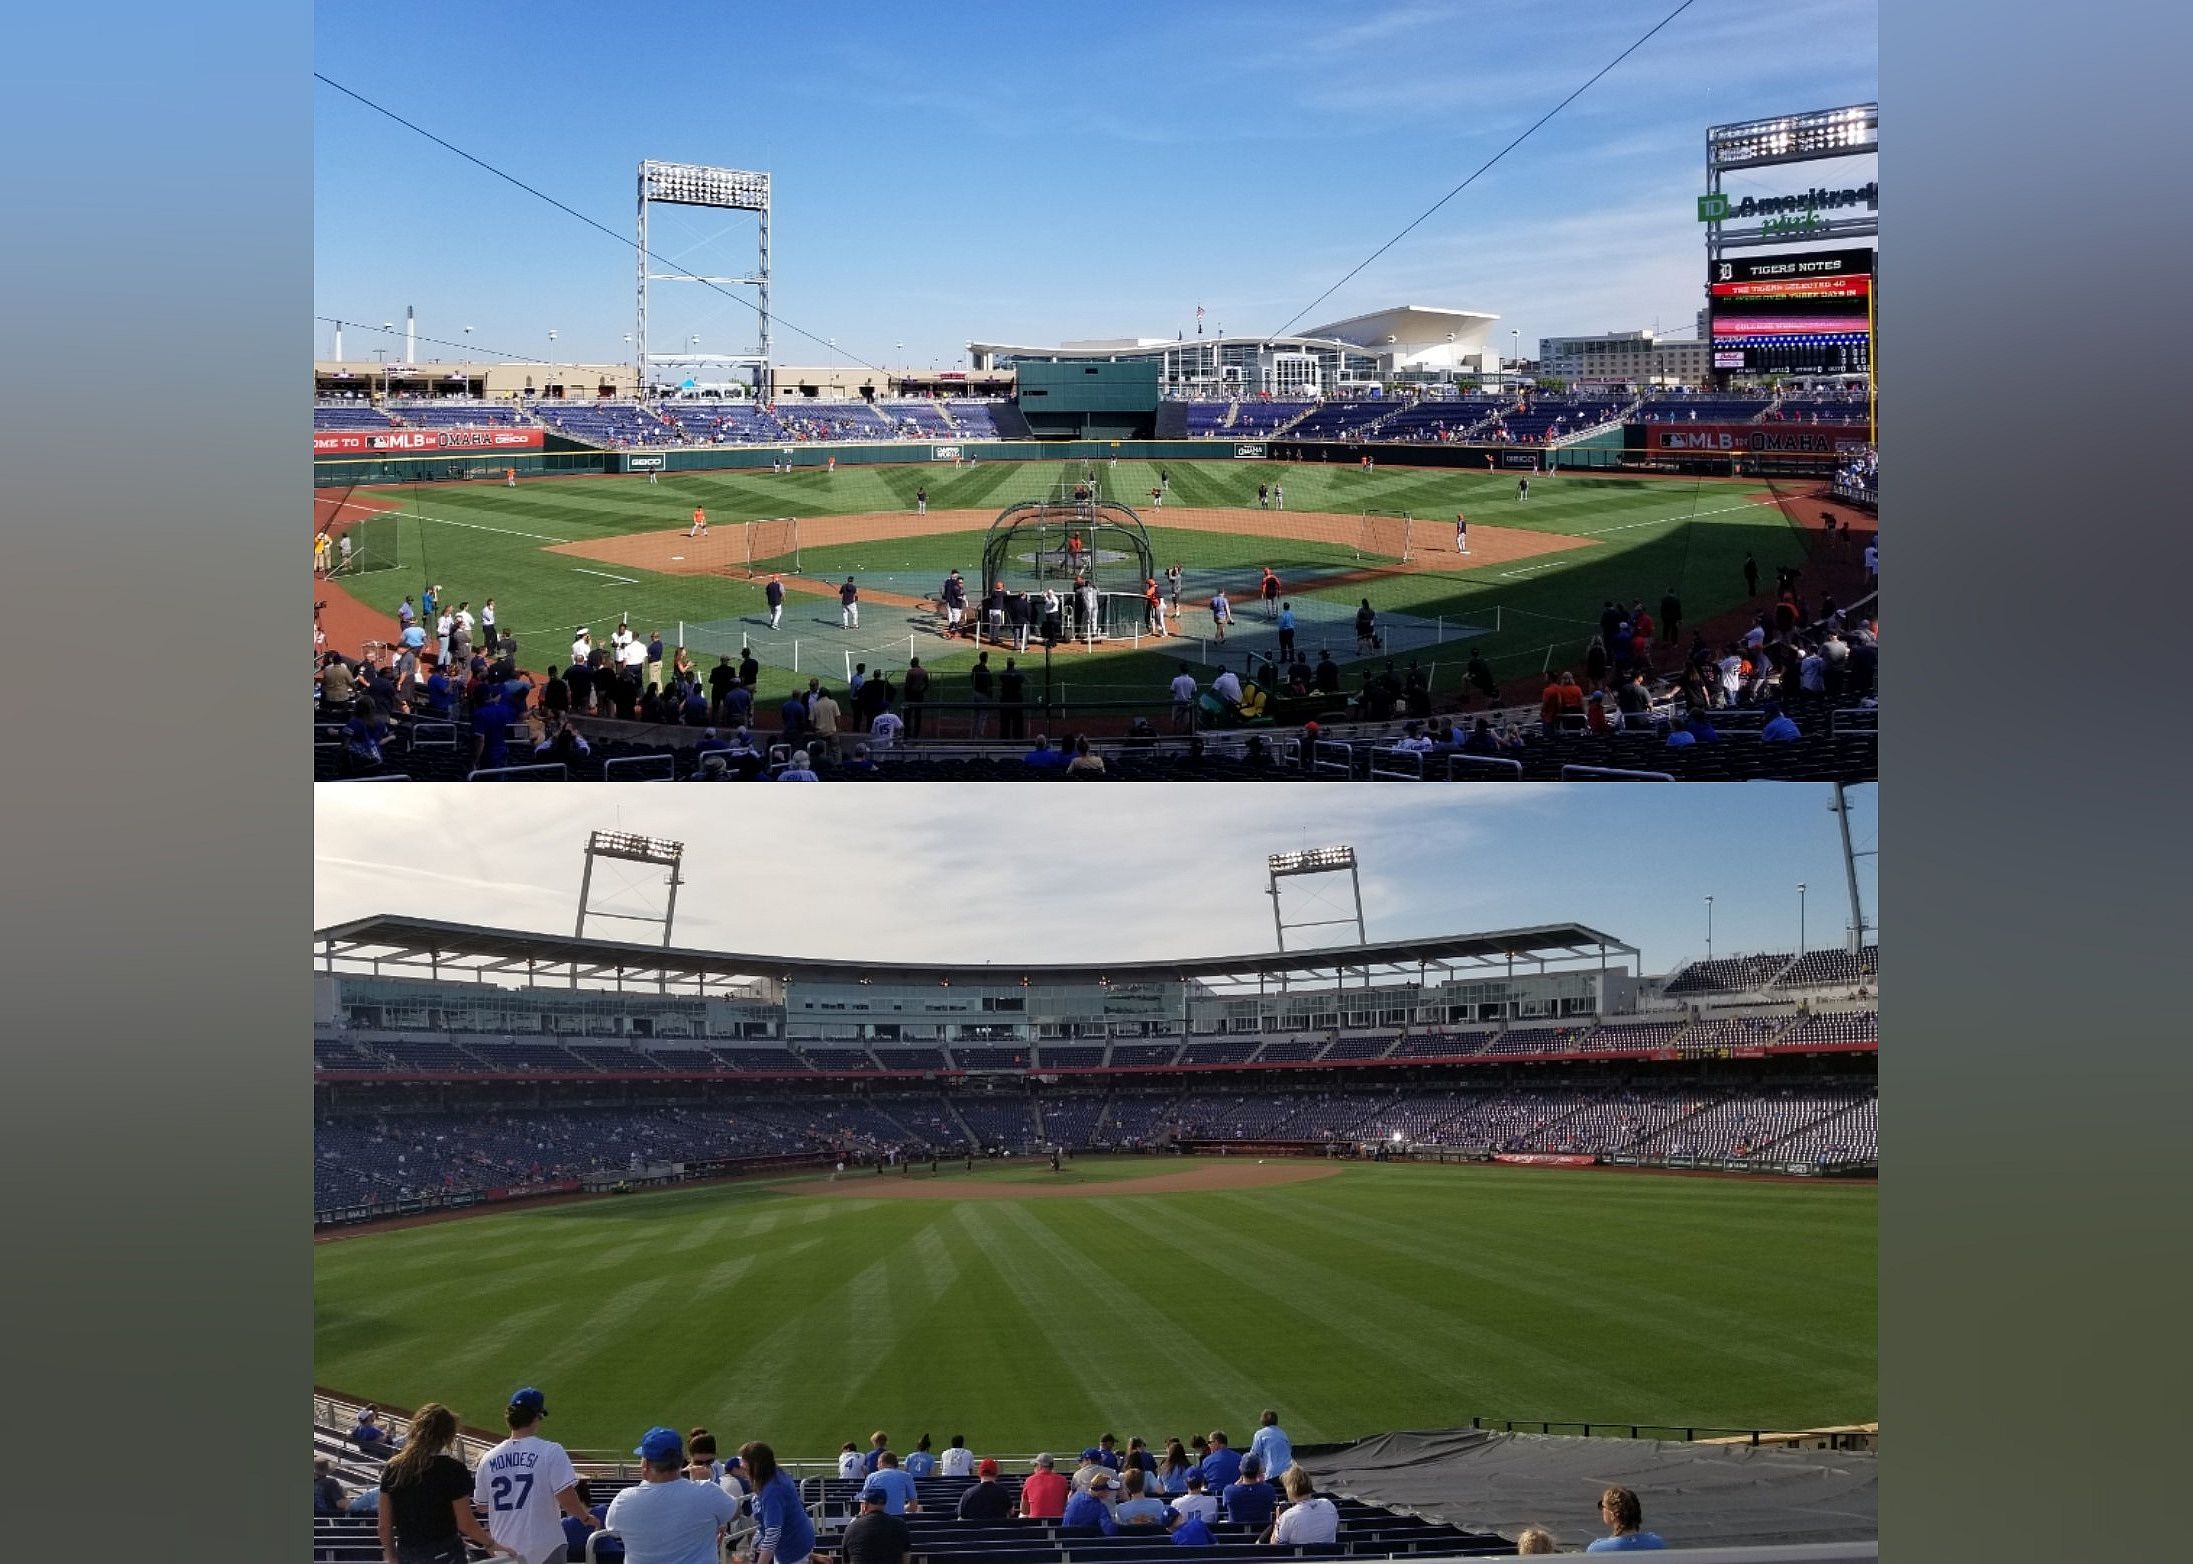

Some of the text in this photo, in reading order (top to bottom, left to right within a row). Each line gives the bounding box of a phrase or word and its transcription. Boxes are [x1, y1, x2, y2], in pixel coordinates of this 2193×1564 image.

[1703, 200, 1724, 217] TD
[1750, 260, 1842, 276] TIGERS NOTES
[342, 439, 359, 447] TO
[390, 434, 425, 448] MLB
[438, 432, 493, 446] OMAHA
[1688, 432, 1733, 449] MLB
[1751, 431, 1830, 451] OMAHA
[490, 1451, 539, 1473] MONDESI
[491, 1473, 534, 1512] 27
